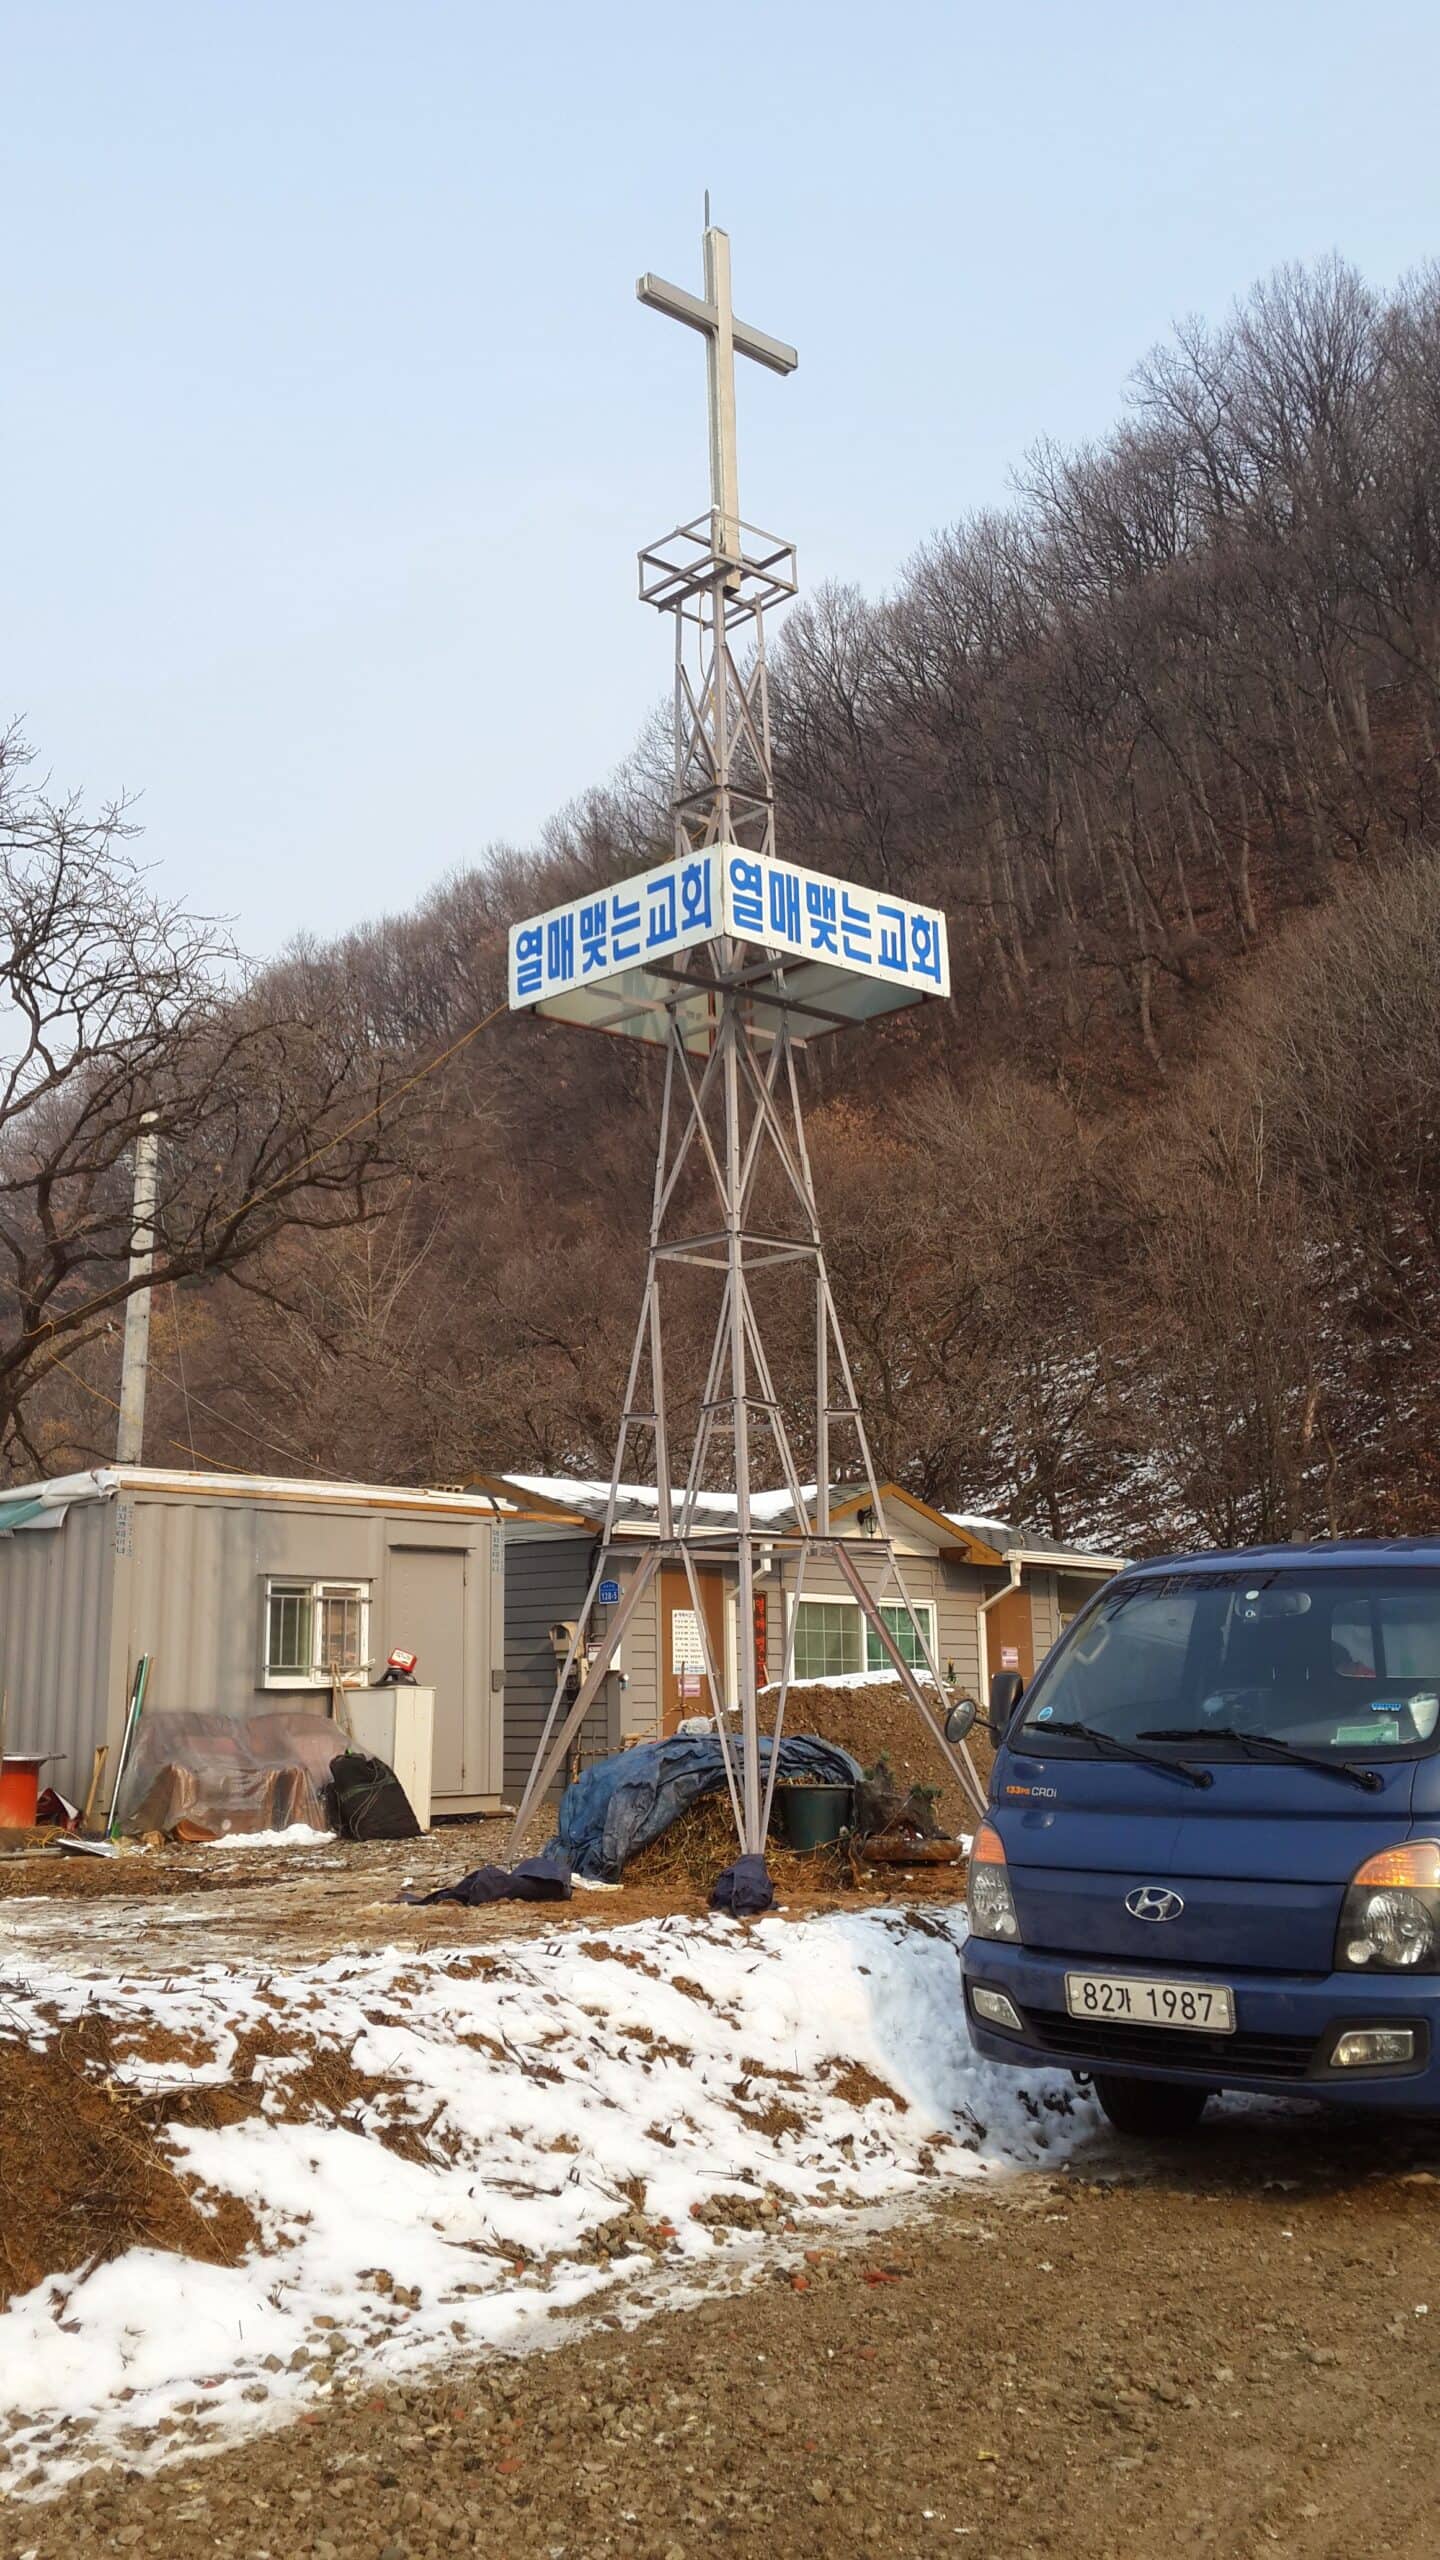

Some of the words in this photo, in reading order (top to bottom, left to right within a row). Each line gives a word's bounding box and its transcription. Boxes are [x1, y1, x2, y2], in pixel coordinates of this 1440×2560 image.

[516, 858, 712, 995] 열매맺는교회
[730, 858, 941, 984] 열매맺는교회
[1083, 1982, 1131, 2013] 82가
[1146, 1988, 1213, 2022] 1987
